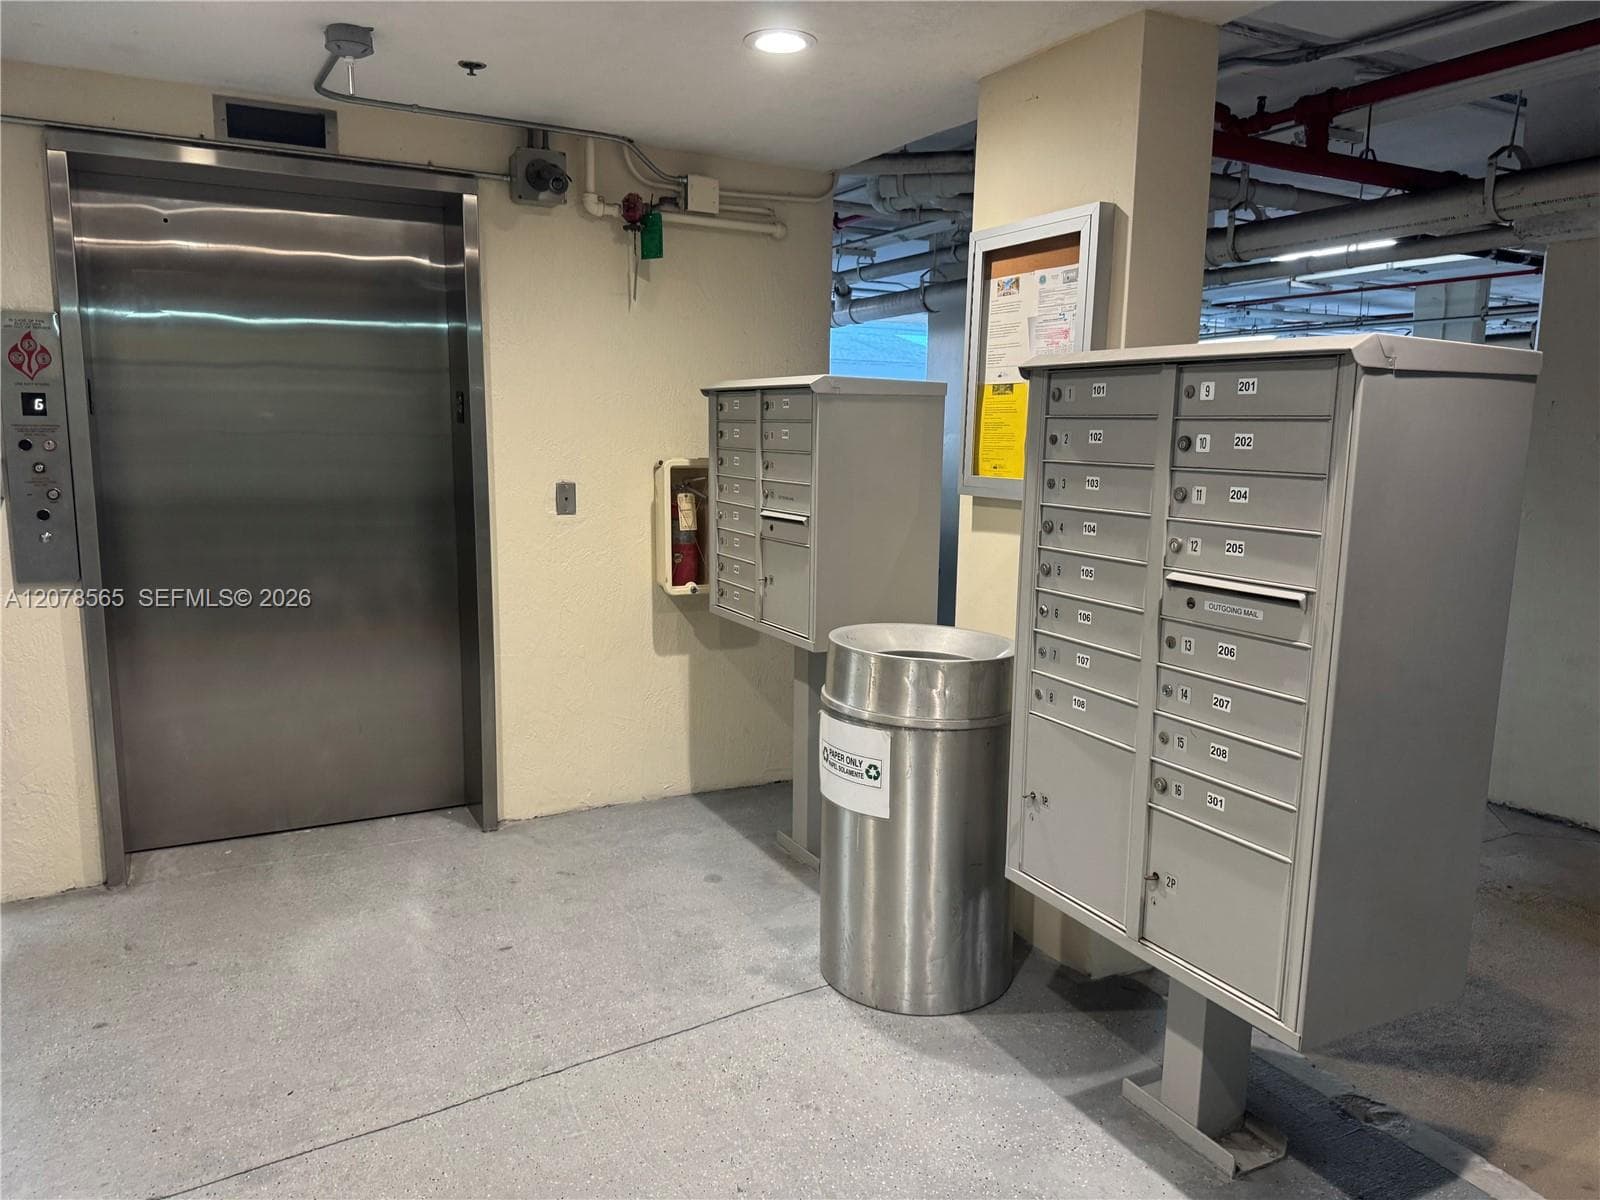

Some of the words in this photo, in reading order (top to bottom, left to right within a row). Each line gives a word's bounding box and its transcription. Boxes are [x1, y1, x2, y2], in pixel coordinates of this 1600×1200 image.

[1093, 385, 1105, 396] 101
[1204, 385, 1210, 397] 9
[1238, 381, 1256, 392] 201
[1090, 432, 1103, 442] 102
[1234, 436, 1253, 447] 202
[1199, 437, 1207, 450] 10
[1086, 478, 1099, 489] 103
[1196, 489, 1202, 501] 11
[1230, 489, 1248, 501] 204
[1084, 523, 1096, 534] 104
[1190, 540, 1198, 552] 12
[1225, 543, 1244, 554] 205
[1081, 567, 1094, 578] 105
[1208, 602, 1242, 615] OUTGOING
[1243, 609, 1259, 618] MAIL
[1078, 611, 1091, 622] 106
[1184, 639, 1192, 652] 13
[1218, 644, 1236, 658] 206
[1077, 655, 1089, 666] 107
[1180, 688, 1188, 700] 14
[1073, 697, 1085, 709] 108
[1213, 696, 1230, 710] 207
[1177, 737, 1184, 749] 15
[829, 748, 845, 762] PAPER
[845, 756, 864, 768] ONLY
[1210, 745, 1227, 759] 208
[838, 765, 864, 779] SOLAMENTE
[1174, 784, 1182, 796] 16
[1207, 794, 1223, 809] 301
[1166, 876, 1176, 888] 2P
